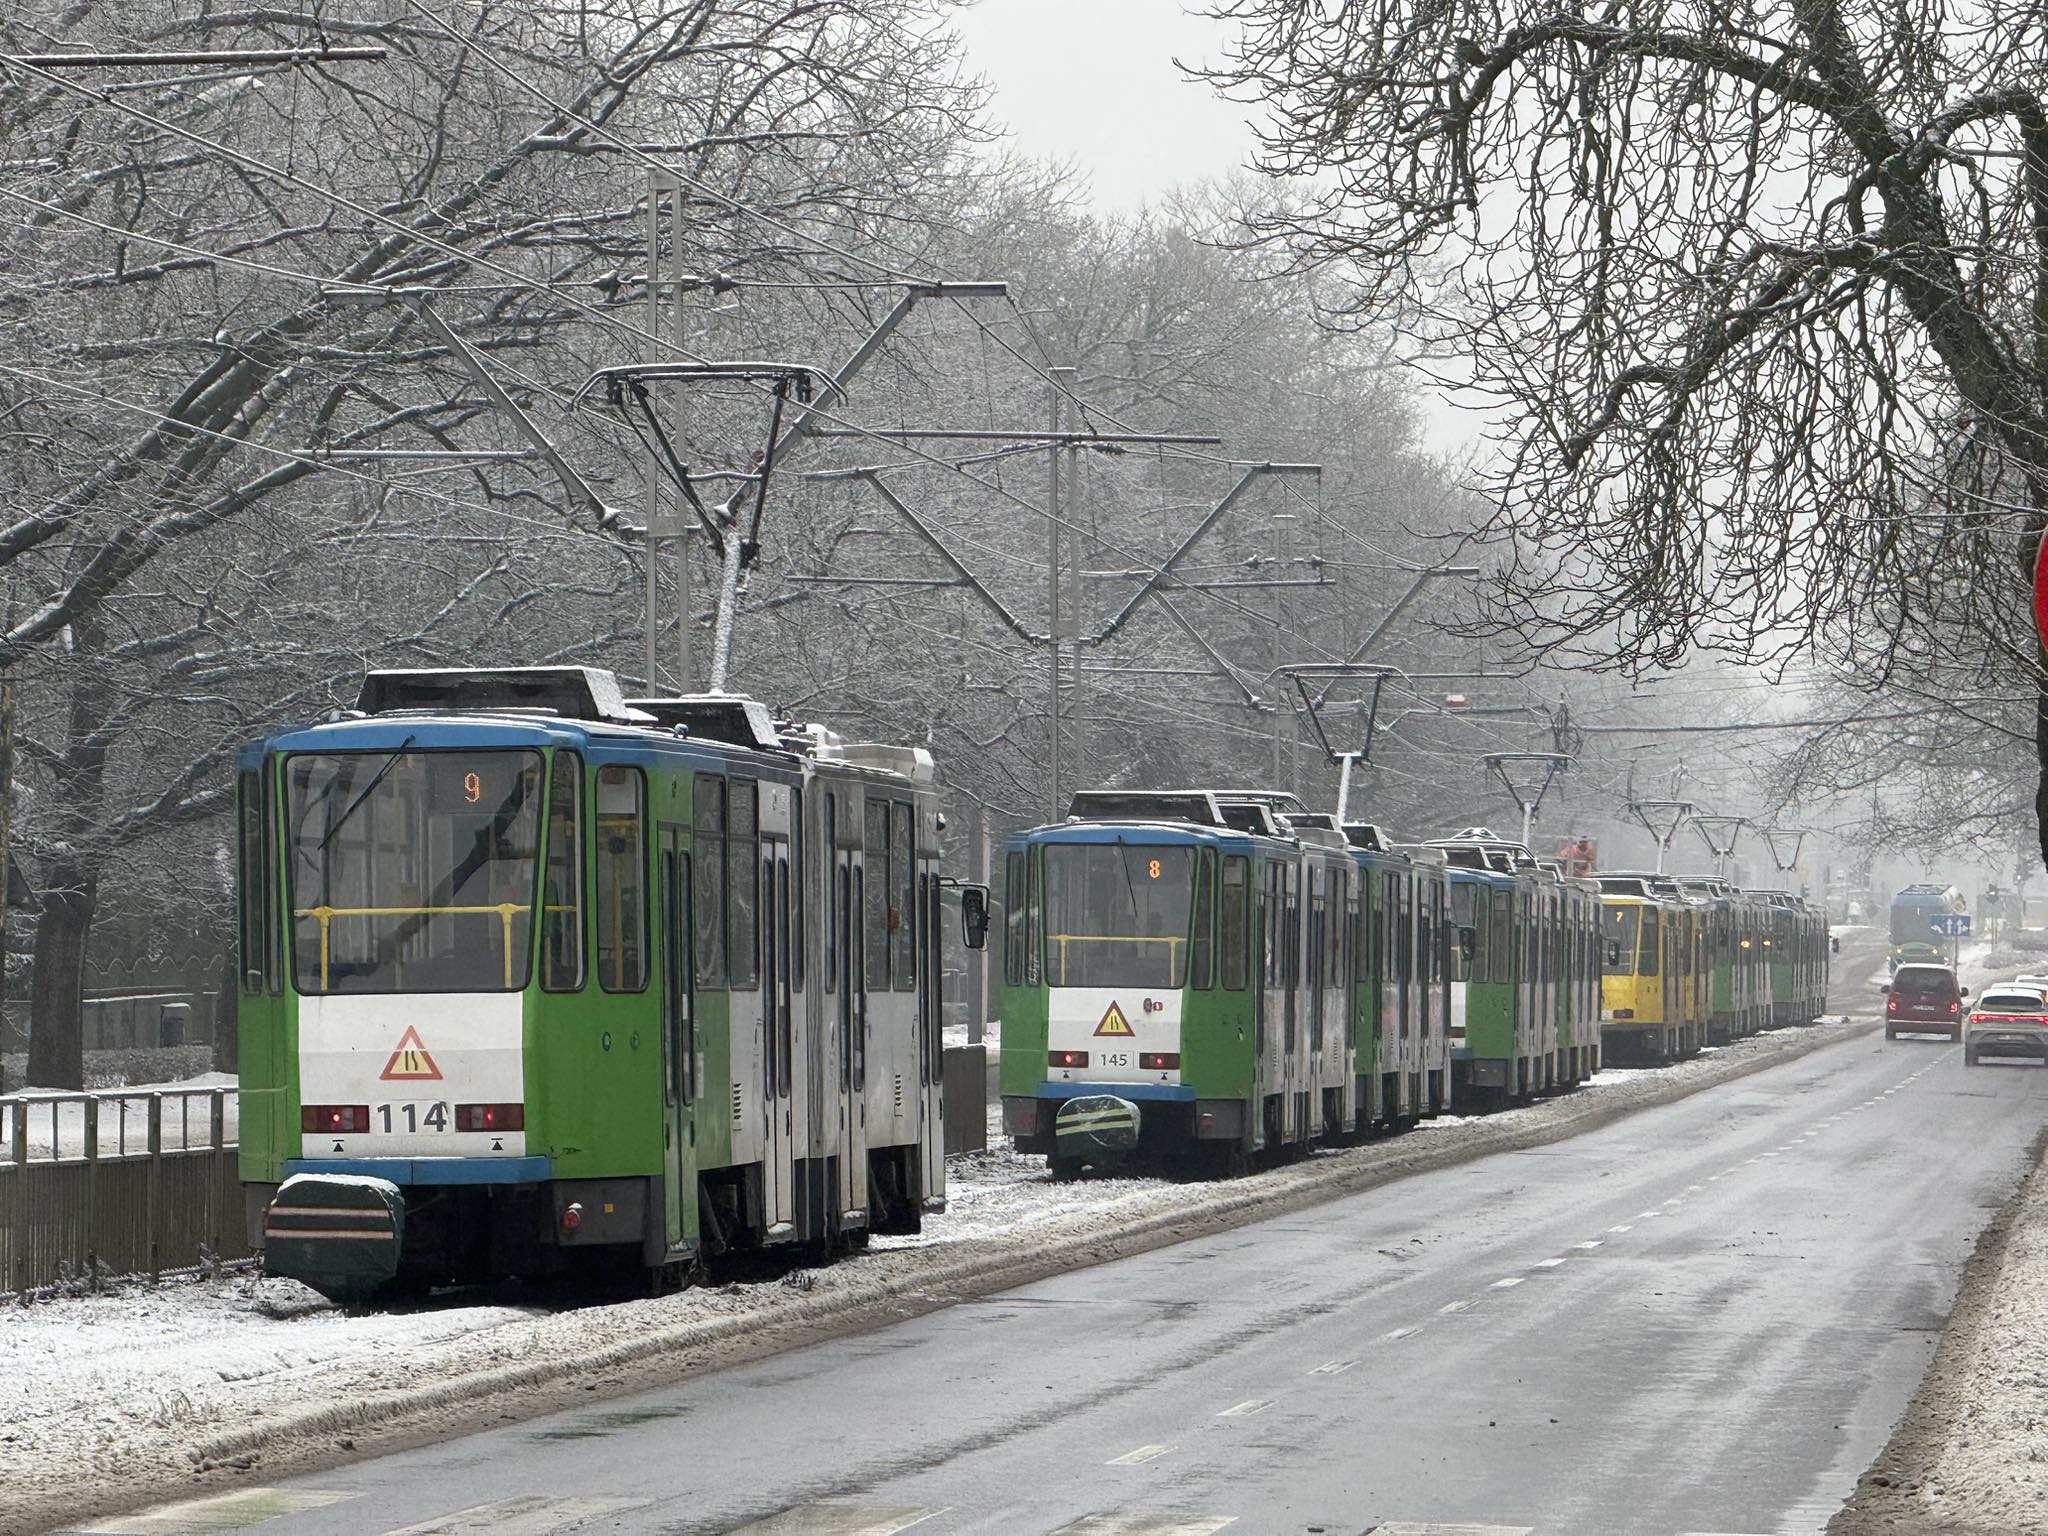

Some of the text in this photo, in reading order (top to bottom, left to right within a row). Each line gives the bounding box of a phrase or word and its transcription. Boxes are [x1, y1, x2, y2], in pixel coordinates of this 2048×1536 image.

[464, 772, 480, 802] 9
[1149, 860, 1160, 878] 8
[1100, 1053, 1128, 1067] 145
[376, 1101, 448, 1133] 114
